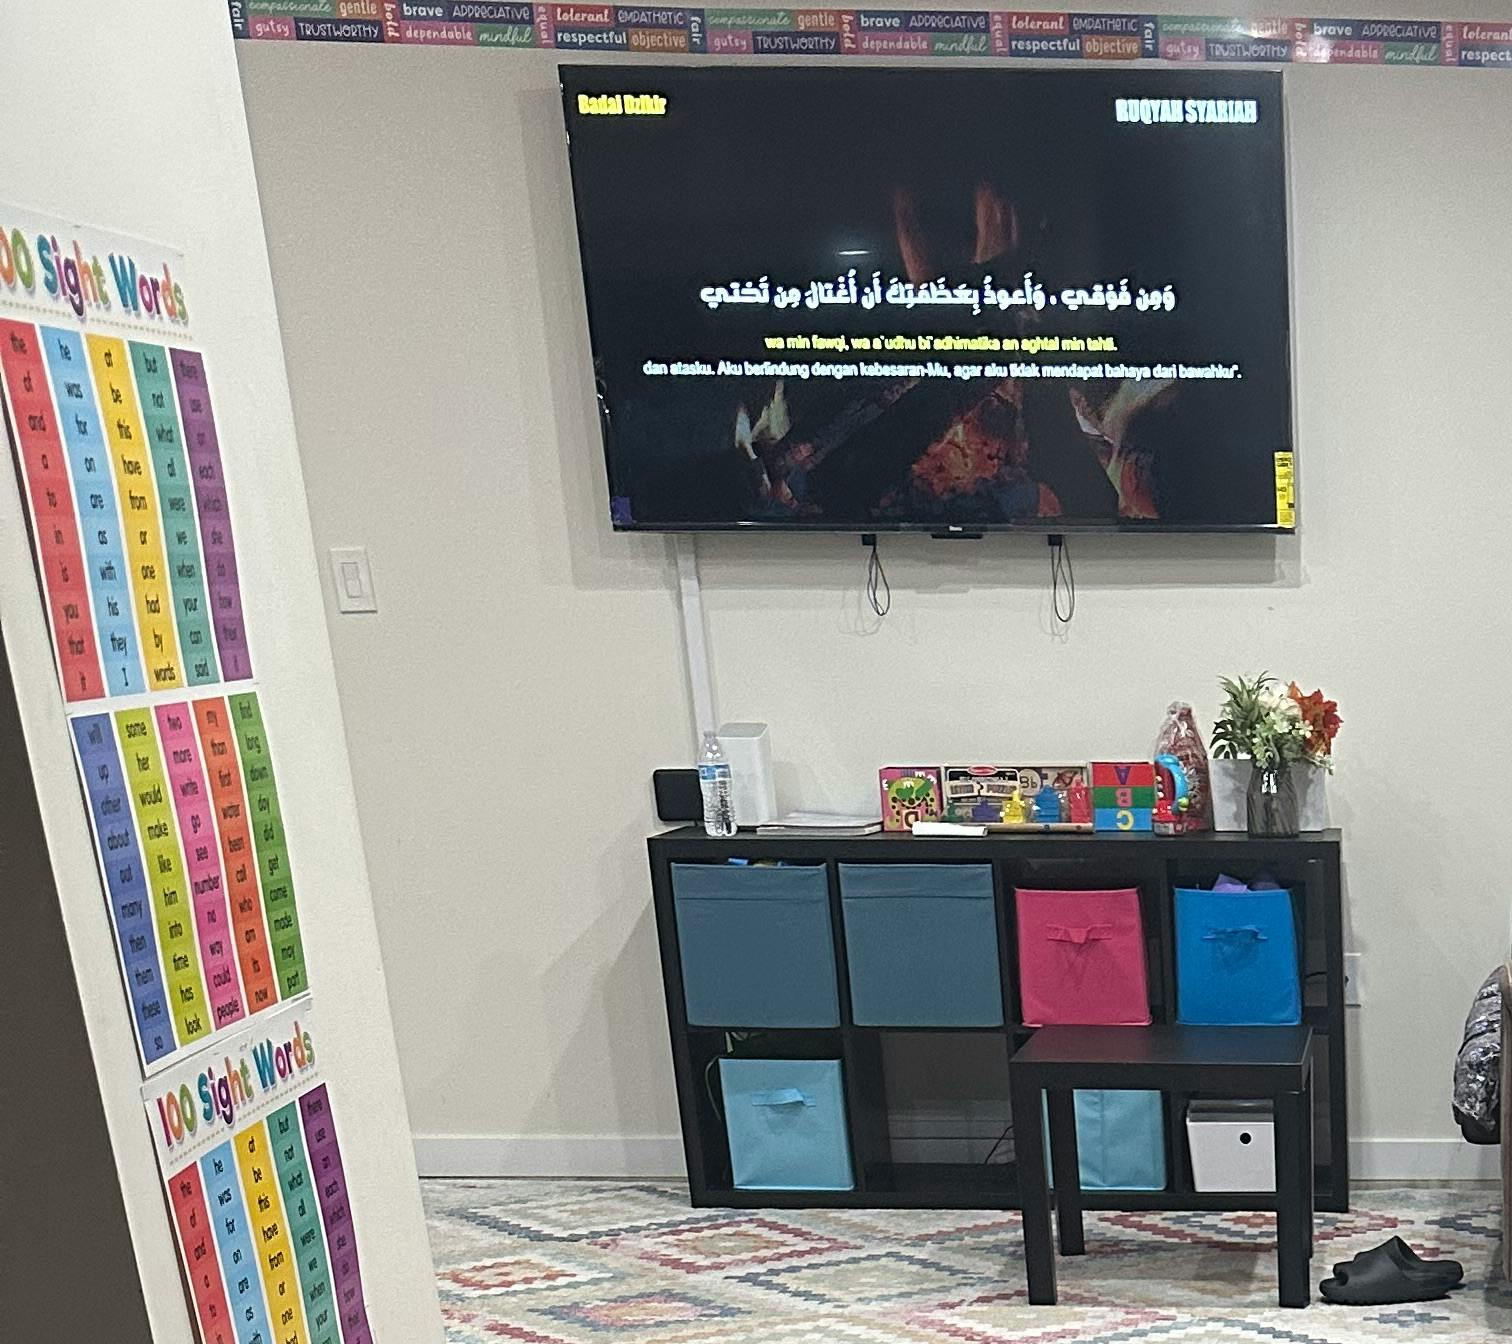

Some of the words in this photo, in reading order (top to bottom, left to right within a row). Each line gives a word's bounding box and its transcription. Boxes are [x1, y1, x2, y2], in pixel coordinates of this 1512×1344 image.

[339, 0, 378, 17] gentle
[403, 4, 444, 17] brave
[556, 7, 610, 22] tolerant
[255, 20, 289, 36] gutsy
[798, 12, 835, 30] gentle
[860, 14, 900, 27] brave
[1011, 16, 1065, 30] tolerant
[298, 22, 379, 38] TRUSTWORTHY
[406, 26, 473, 41] dependable
[479, 26, 533, 43] mindful
[691, 16, 703, 45] fair
[841, 14, 855, 49] bold
[1144, 21, 1155, 51] fair
[1313, 23, 1353, 36] brave
[557, 31, 627, 46] respectful
[632, 32, 686, 48] objective
[714, 34, 747, 51] gutsy
[756, 36, 836, 50] TRUSTWORTHY
[862, 36, 928, 51] dependable
[934, 35, 988, 52] mindful
[1011, 38, 1080, 53] respectful
[1085, 39, 1139, 56] objective
[37, 234, 110, 317] Sight
[108, 252, 188, 321] Words
[642, 360, 668, 375] dan
[811, 362, 859, 379] dengan
[64, 381, 84, 399] was
[121, 454, 142, 476] have
[157, 1083, 198, 1148] 100
[197, 1056, 255, 1126] Sight
[252, 1021, 315, 1090] Words
